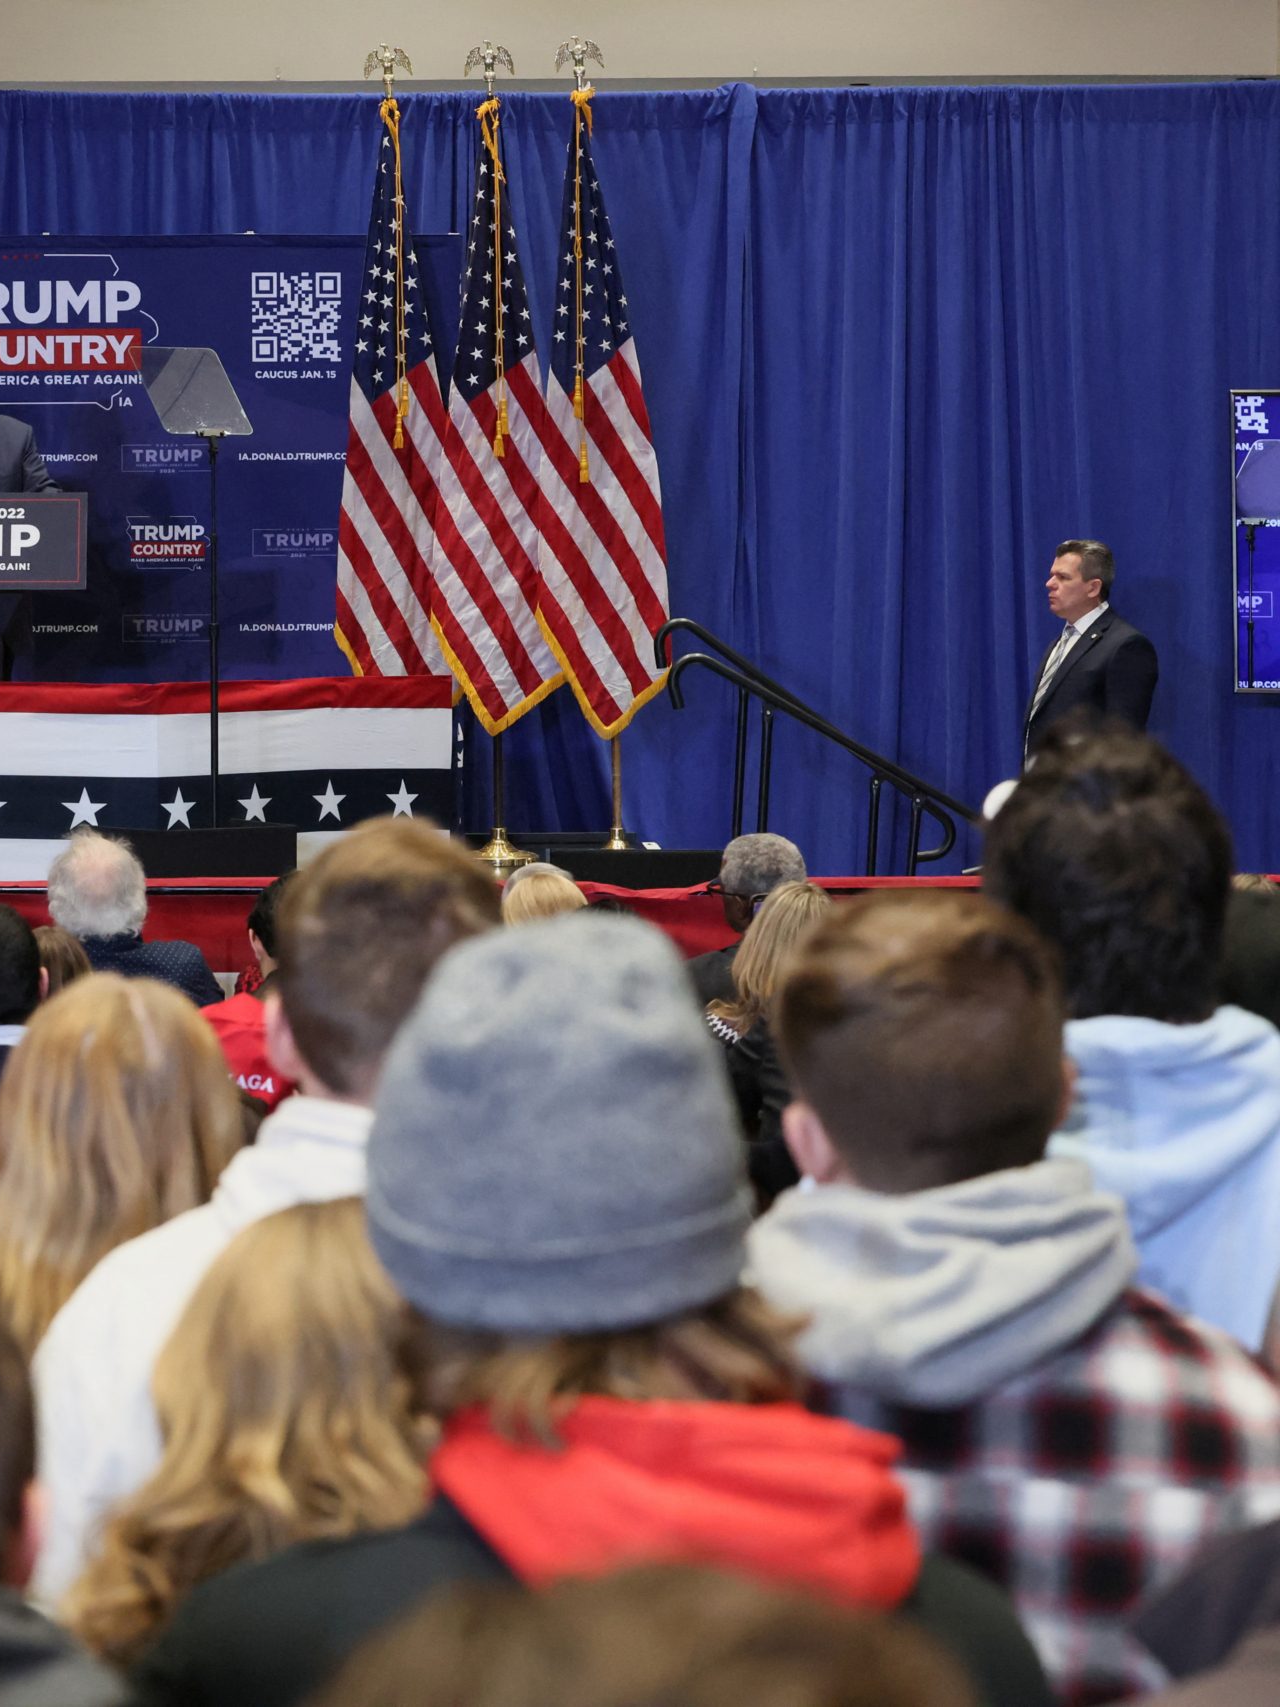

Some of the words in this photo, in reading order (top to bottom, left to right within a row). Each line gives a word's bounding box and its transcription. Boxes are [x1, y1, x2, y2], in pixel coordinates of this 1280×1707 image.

[44, 375, 89, 385] GREAT
[93, 374, 143, 385] AGAIN!
[254, 371, 298, 379] CAUCUS
[300, 371, 324, 379] JAN.
[326, 371, 337, 379] 15
[119, 397, 134, 407] IA
[38, 453, 98, 462] TRUMP.COM
[132, 449, 203, 463] TRUMP
[238, 452, 347, 461] IA.DONALDJTRUMP.CO
[131, 525, 205, 541] TRUMP
[263, 533, 334, 547] TRUMP
[133, 544, 202, 555] COUNTRY
[132, 619, 204, 632] TRUMP
[239, 623, 336, 632] IA.DONALDJTRUMP.
[228, 1072, 274, 1094] AGA
